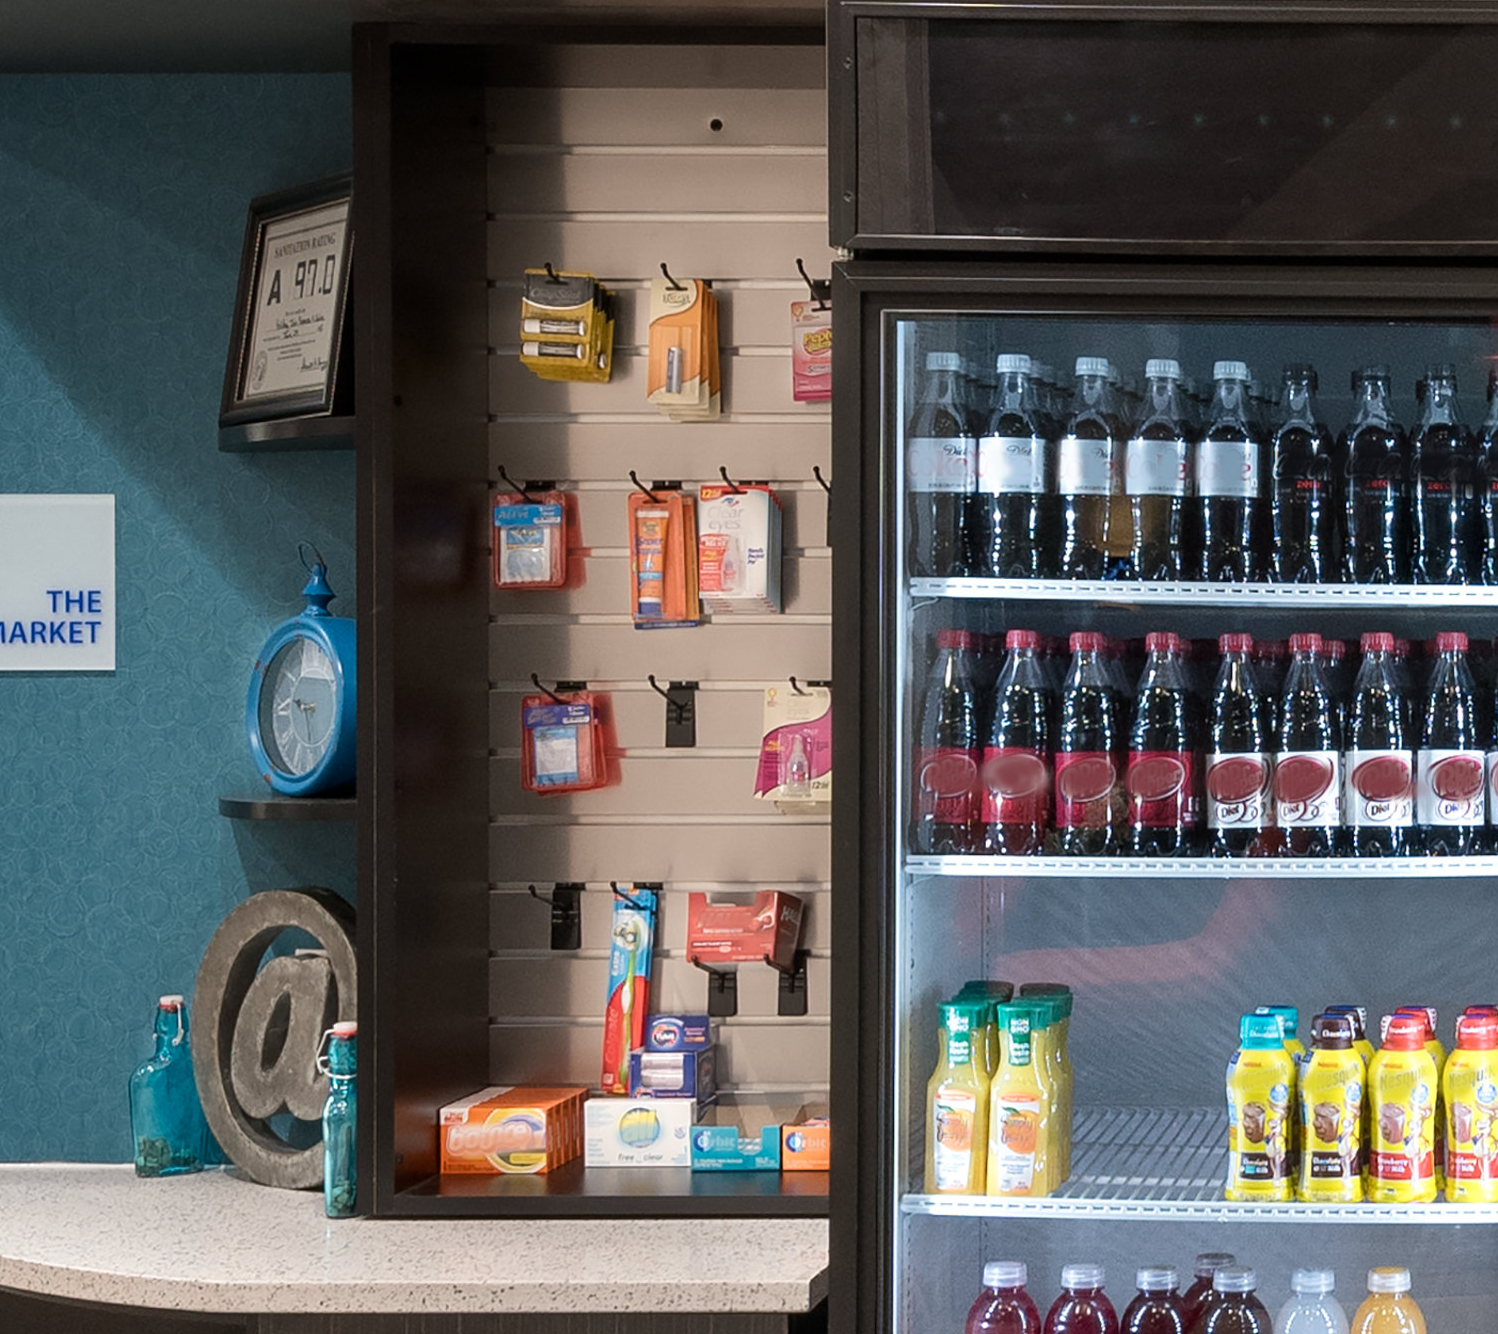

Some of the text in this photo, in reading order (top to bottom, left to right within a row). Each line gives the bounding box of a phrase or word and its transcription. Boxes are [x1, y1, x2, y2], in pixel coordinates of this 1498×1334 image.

[267, 254, 336, 306] A 97.0
[46, 590, 102, 614] THE
[1221, 806, 1240, 816] Diet
